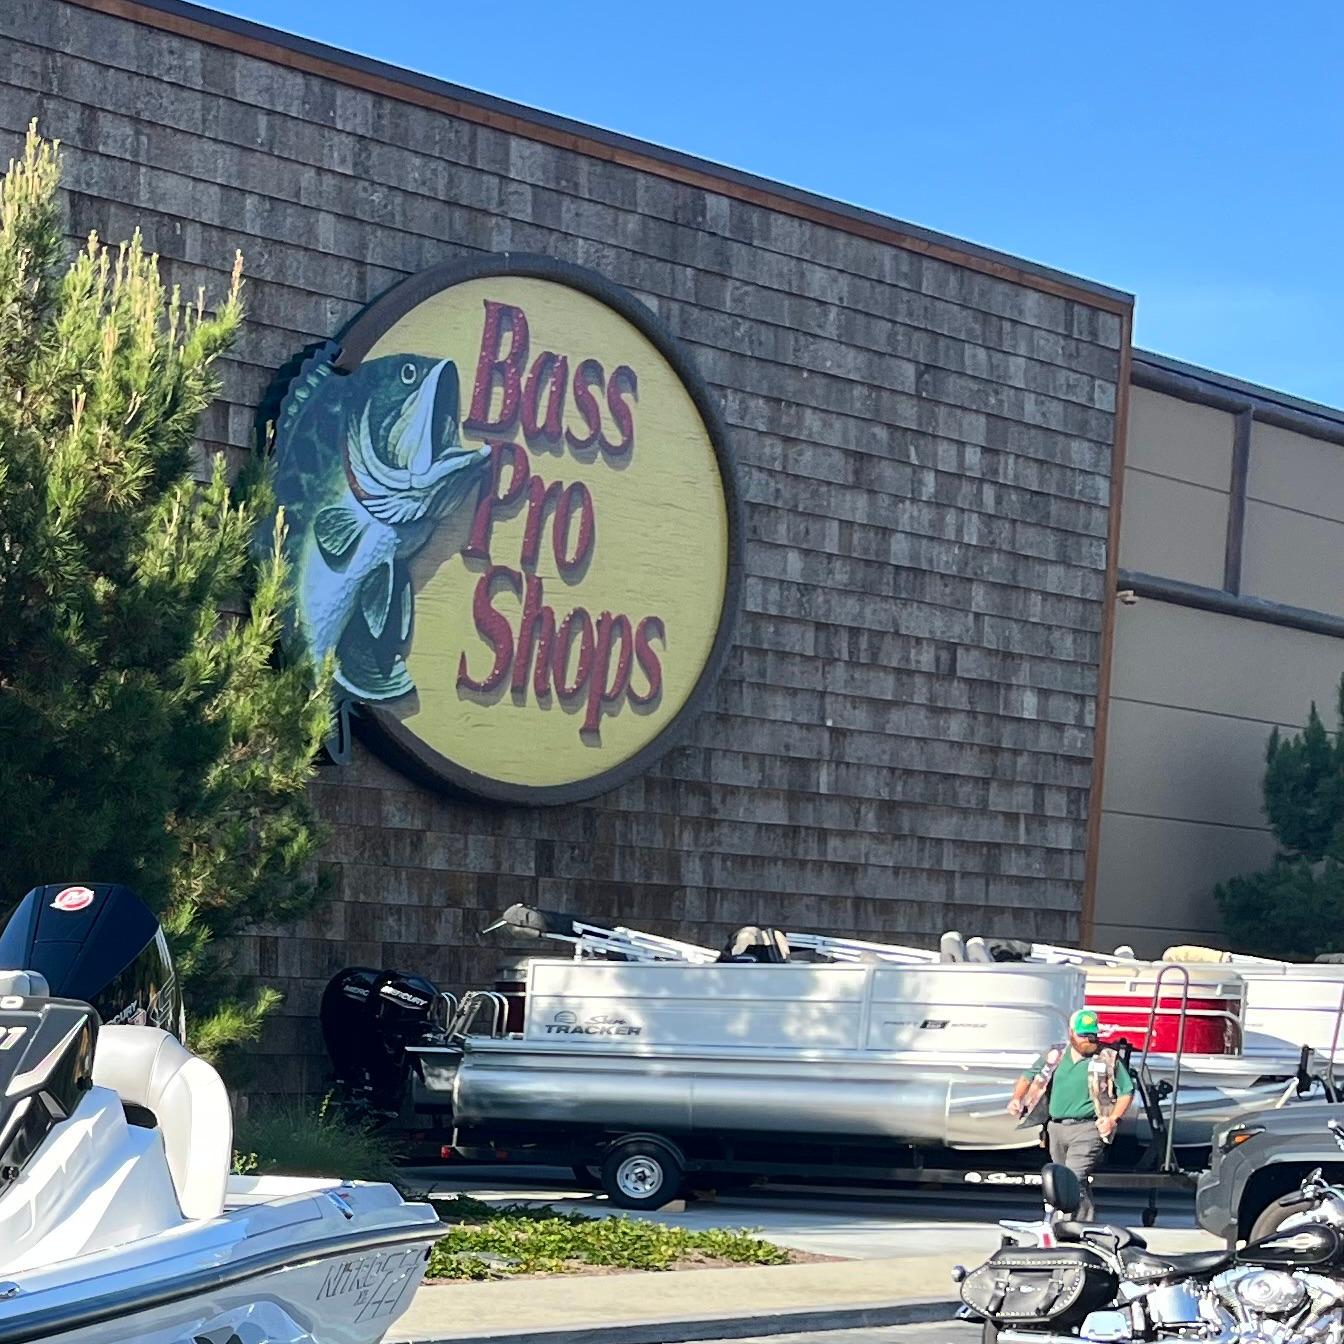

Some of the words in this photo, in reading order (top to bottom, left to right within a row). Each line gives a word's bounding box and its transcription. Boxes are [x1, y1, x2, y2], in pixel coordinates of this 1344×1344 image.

[462, 299, 639, 456] Bass
[461, 440, 596, 571] Pro
[456, 564, 667, 733] Shops
[545, 1024, 642, 1036] TRACKER
